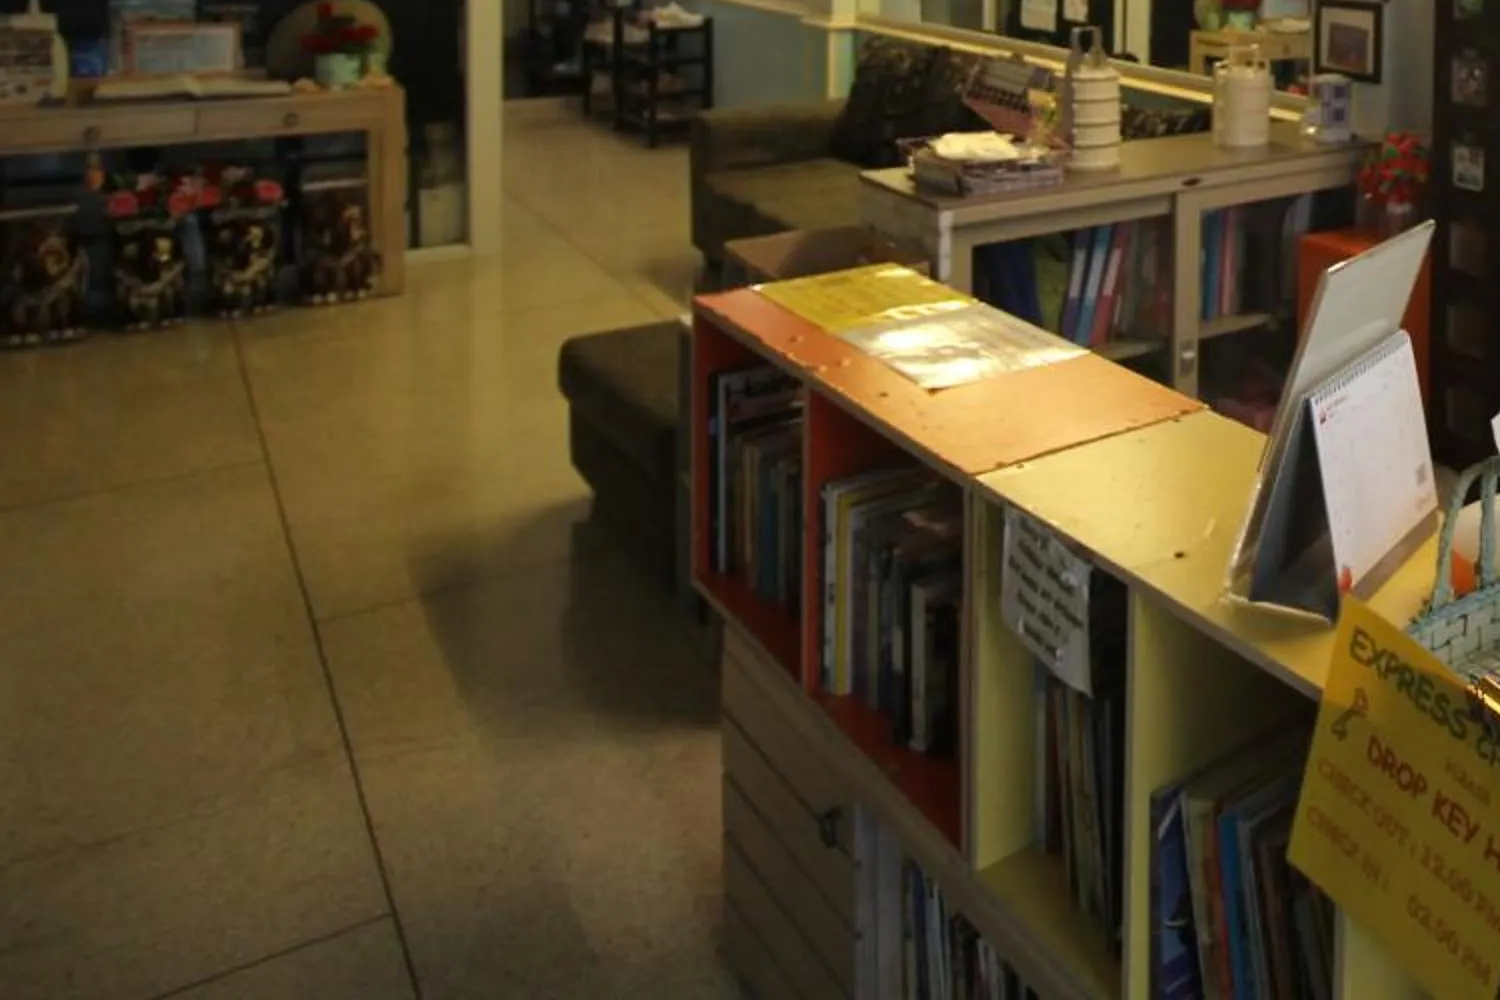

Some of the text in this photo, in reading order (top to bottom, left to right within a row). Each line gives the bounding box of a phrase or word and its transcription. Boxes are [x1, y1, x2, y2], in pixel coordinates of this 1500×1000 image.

[1350, 627, 1469, 742] EXPRESS
[1317, 758, 1372, 817] CHECK
[1367, 735, 1428, 799] DROP
[1432, 788, 1481, 844] KEY
[1306, 805, 1360, 859] CHECK
